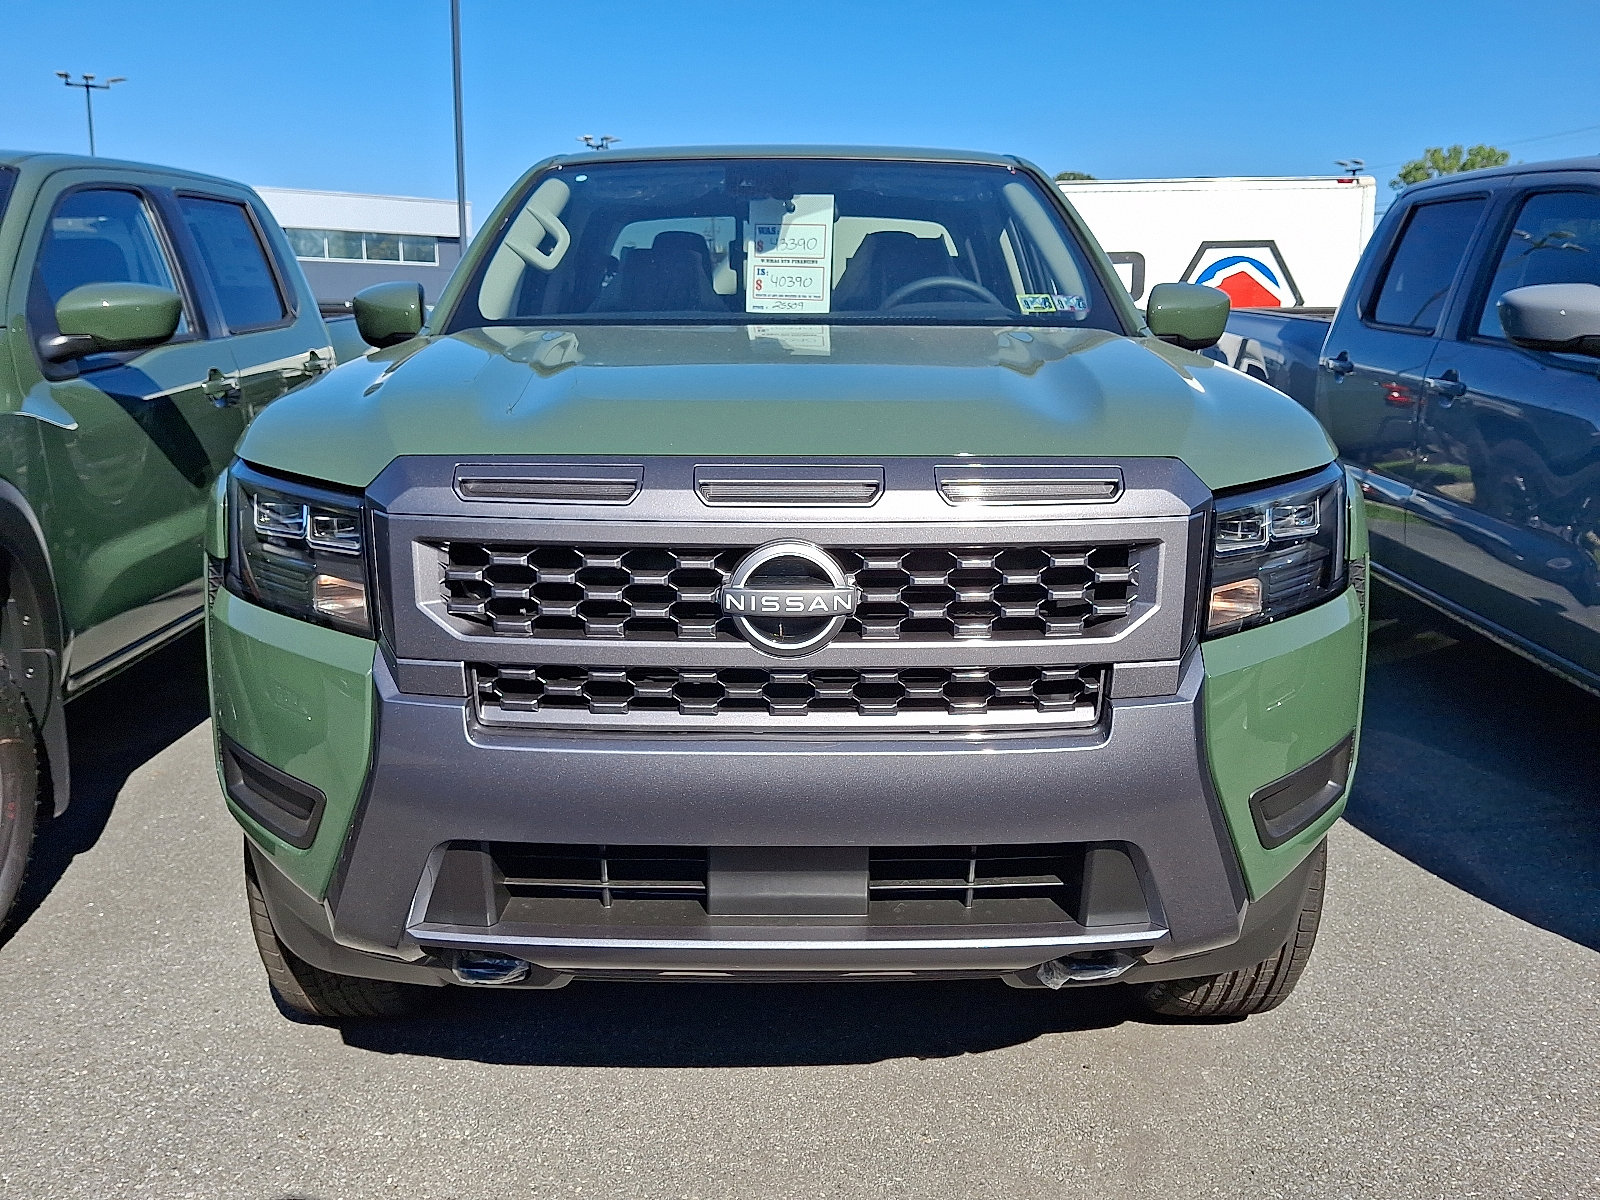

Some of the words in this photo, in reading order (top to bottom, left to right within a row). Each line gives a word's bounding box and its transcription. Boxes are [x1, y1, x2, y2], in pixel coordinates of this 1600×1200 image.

[756, 268, 769, 276] IS:
[770, 274, 813, 288] 40390
[725, 593, 853, 613] NISSAN
